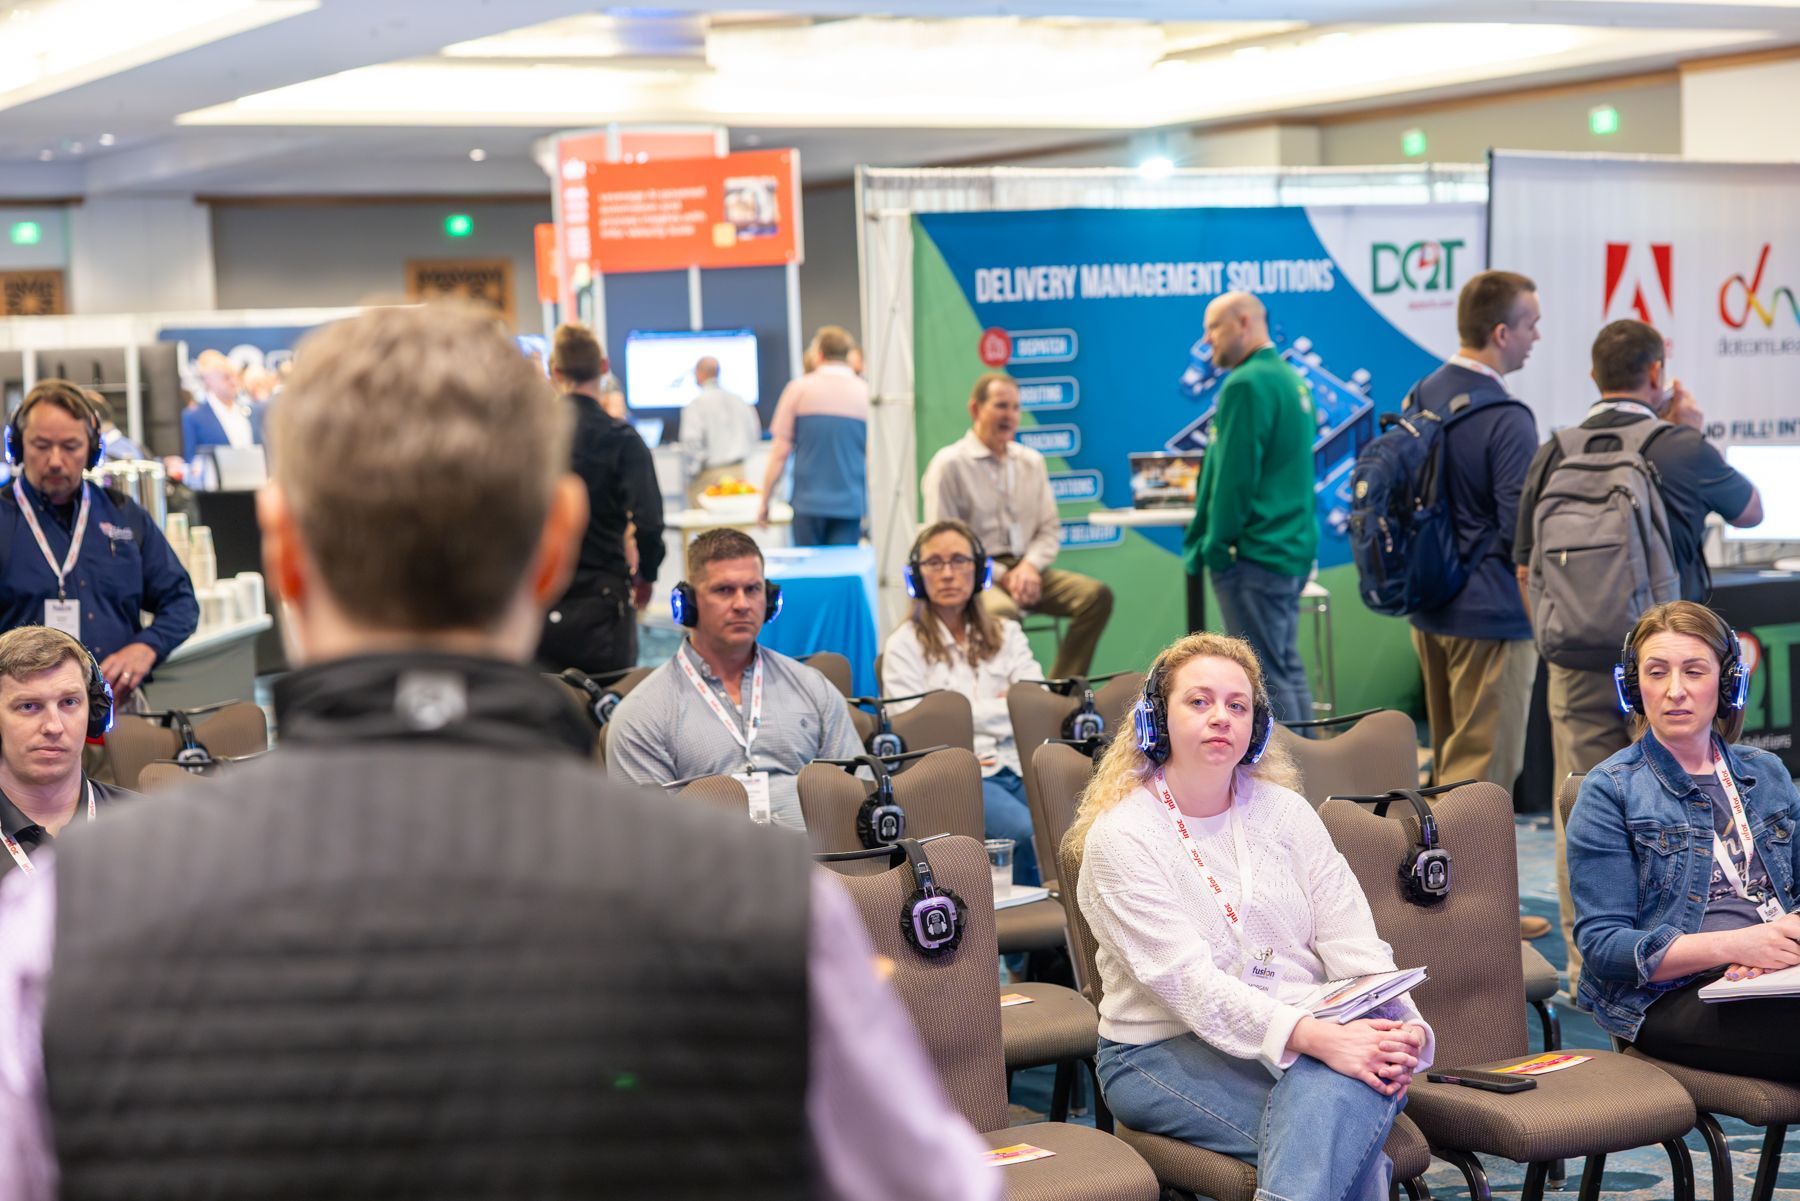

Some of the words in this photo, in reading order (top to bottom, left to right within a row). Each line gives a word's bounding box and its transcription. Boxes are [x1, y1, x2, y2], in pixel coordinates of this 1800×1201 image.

[975, 264, 1078, 303] DELIVERY
[1080, 261, 1224, 299] MANAGEMENT
[1226, 258, 1335, 295] SOLUTIONS
[1163, 790, 1176, 811] infor
[1176, 819, 1190, 840] infor
[1190, 848, 1205, 868] infor
[1207, 875, 1222, 895] infor
[1224, 902, 1239, 927] infor
[1252, 965, 1275, 978] fusion
